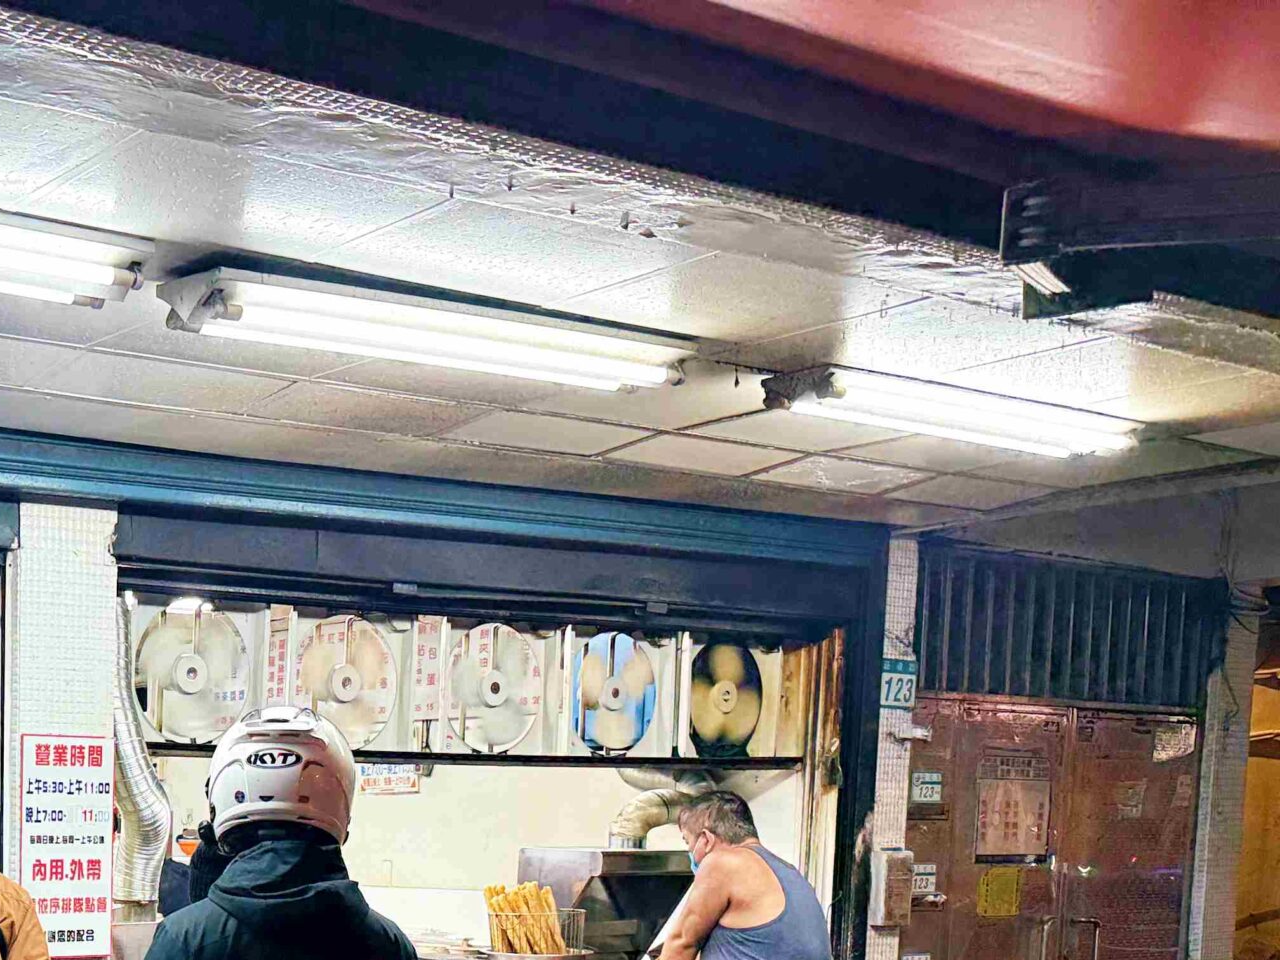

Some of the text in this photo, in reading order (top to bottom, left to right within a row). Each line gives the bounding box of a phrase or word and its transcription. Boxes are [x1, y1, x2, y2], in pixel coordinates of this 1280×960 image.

[884, 676, 914, 703] 123
[35, 743, 103, 767] 營業時間
[252, 751, 299, 767] KYT
[918, 786, 935, 798] 123
[913, 877, 930, 889] 123
[32, 896, 107, 914] 依序排隊點餐
